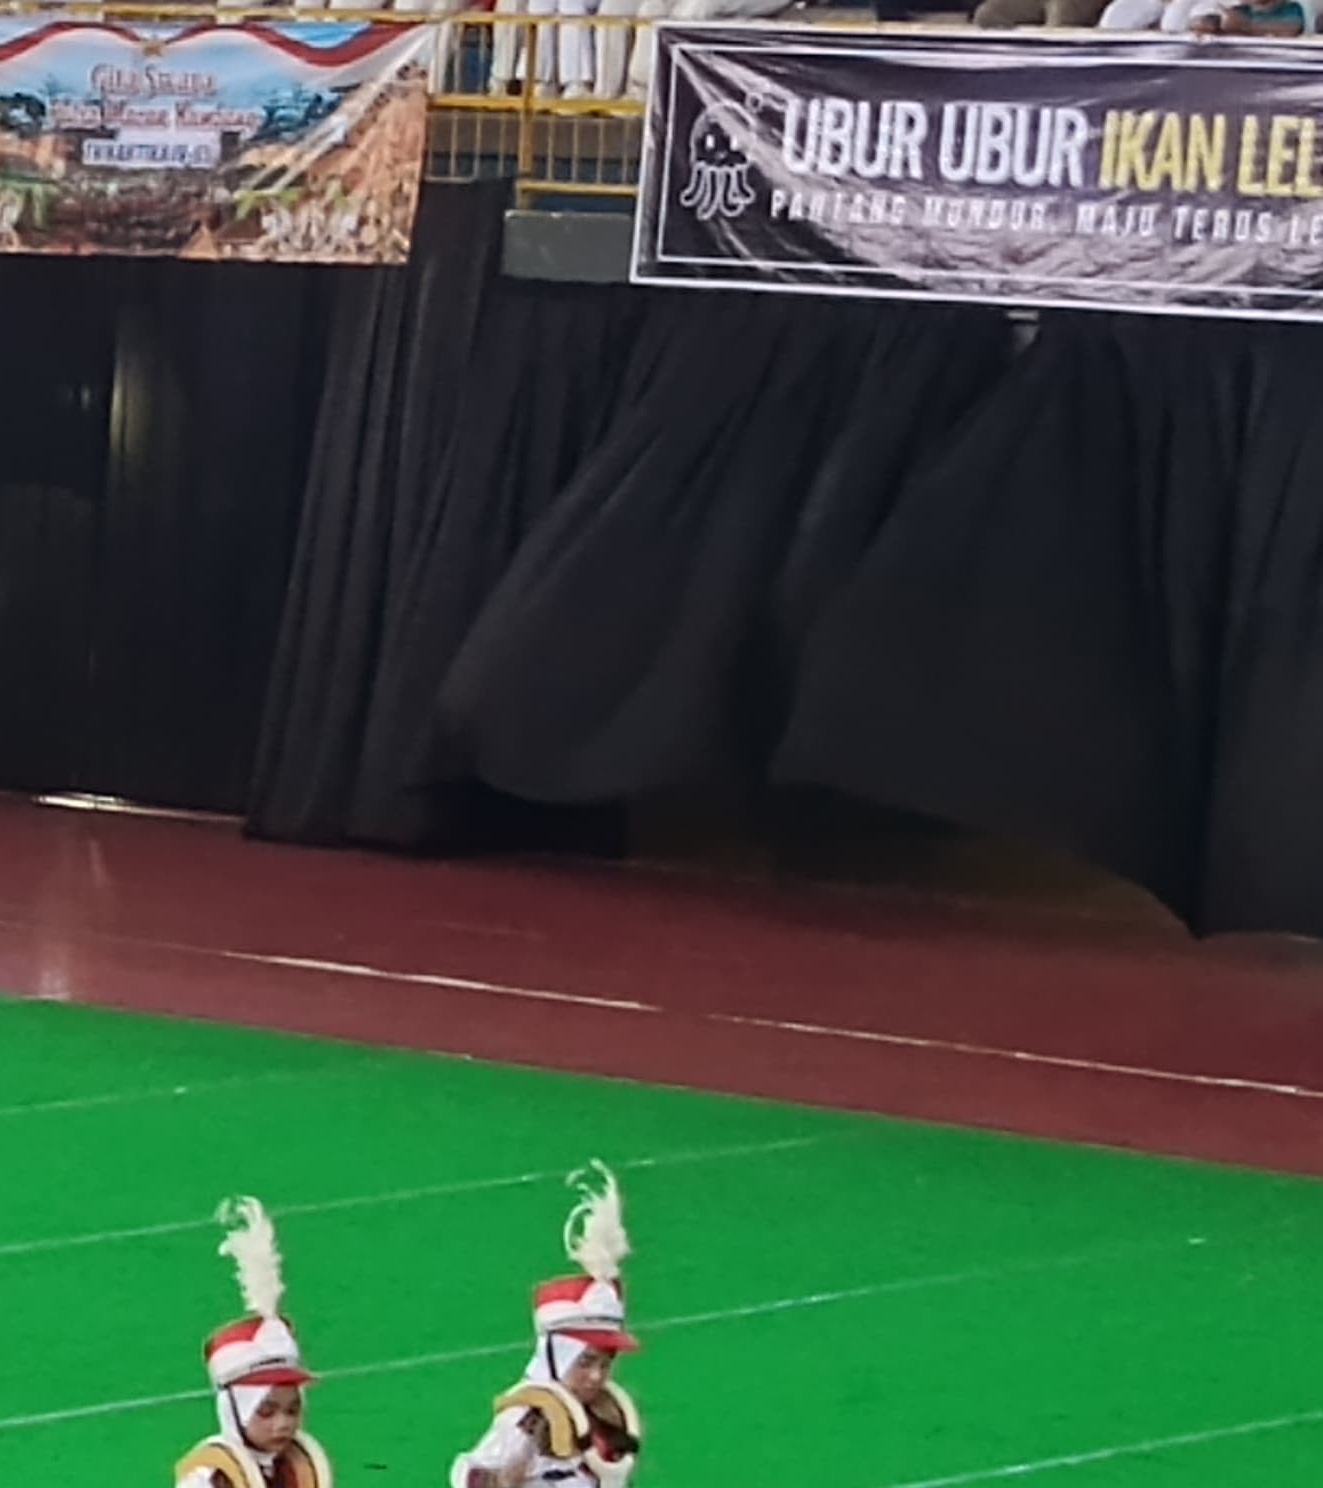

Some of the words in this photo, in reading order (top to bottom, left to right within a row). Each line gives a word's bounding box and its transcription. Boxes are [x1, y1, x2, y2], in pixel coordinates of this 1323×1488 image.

[782, 97, 928, 180] UBUR
[939, 100, 1089, 188] UBUR
[1098, 109, 1226, 191] IKAN
[1076, 203, 1159, 237] MAJU
[1173, 205, 1274, 243] TERUS
